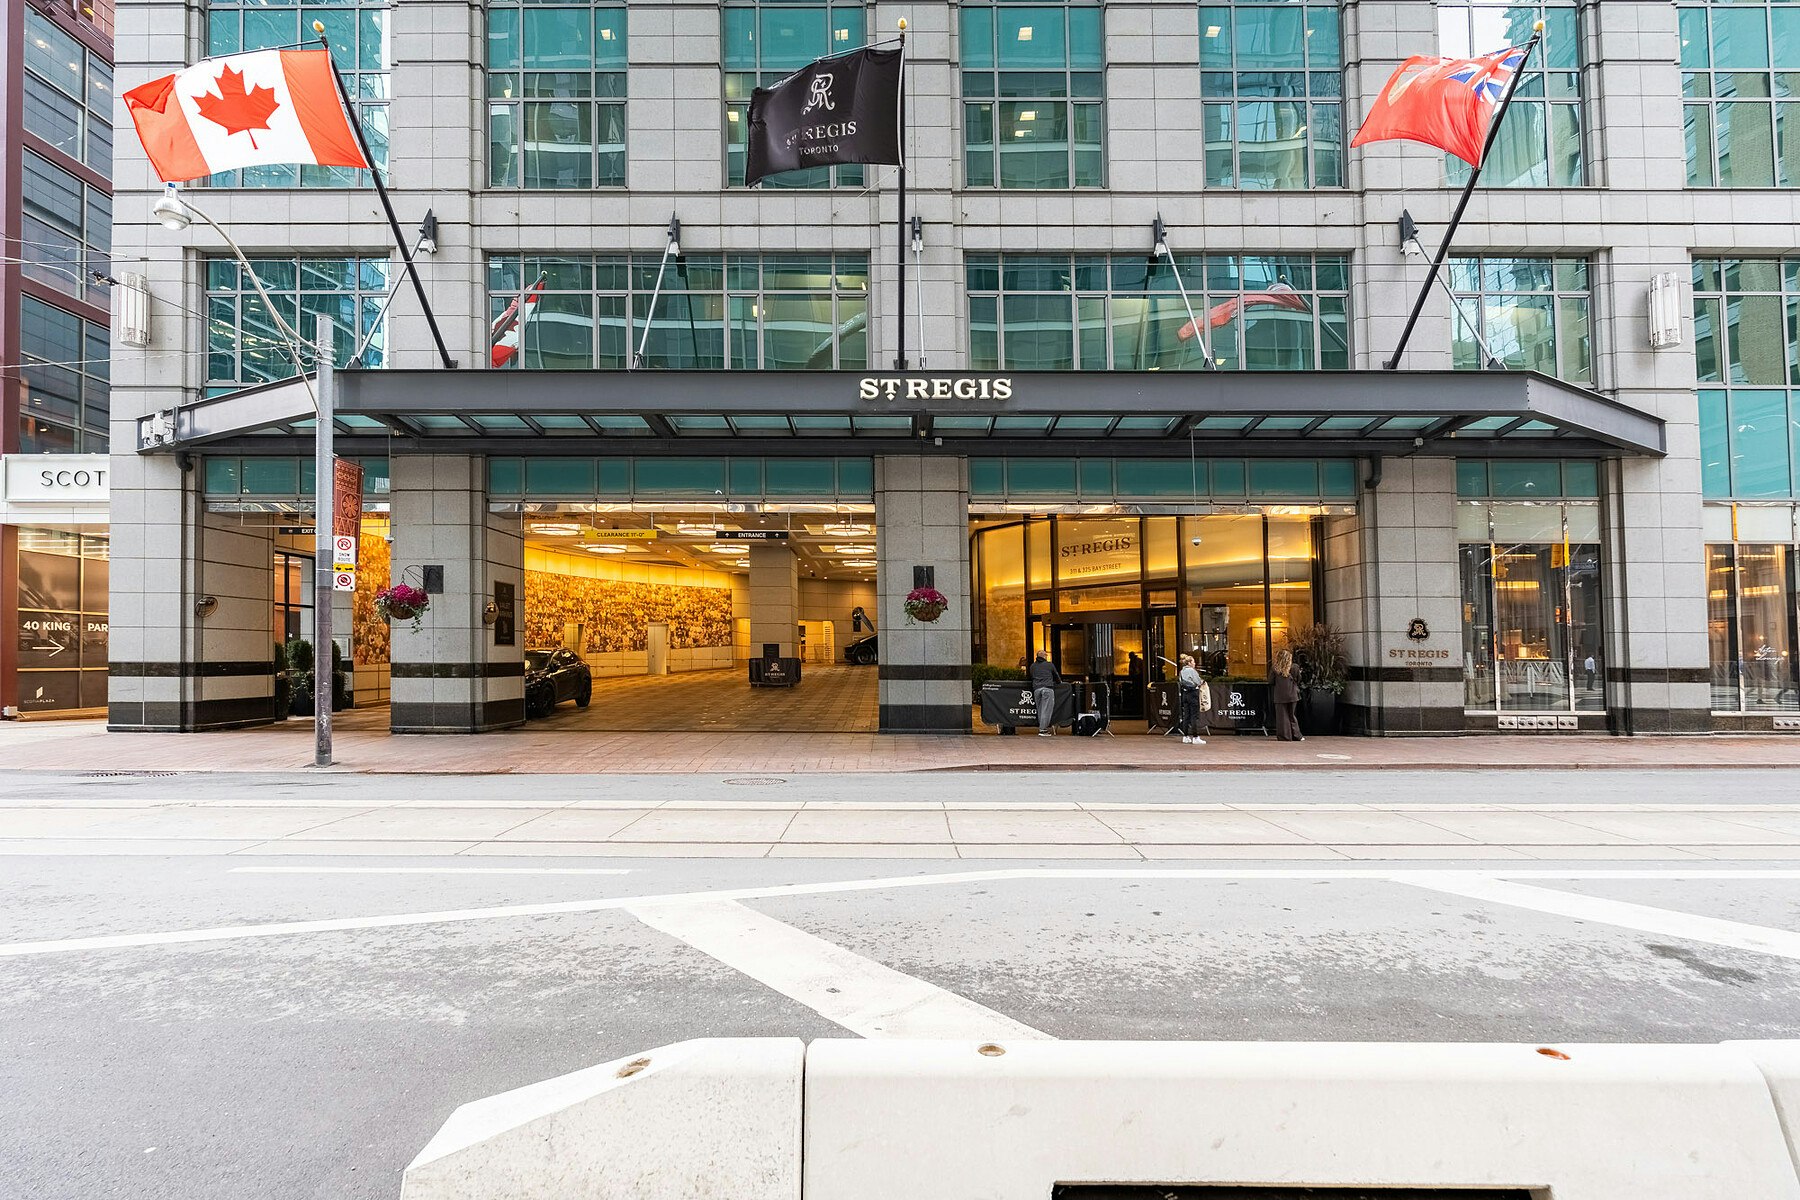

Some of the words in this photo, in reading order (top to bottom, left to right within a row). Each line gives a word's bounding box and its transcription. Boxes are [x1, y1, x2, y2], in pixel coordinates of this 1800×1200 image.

[799, 144, 839, 155] TORONTO
[905, 378, 1013, 400] REGIS
[41, 470, 106, 487] SCOT
[1082, 537, 1131, 554] REGIS
[1102, 563, 1121, 571] STREET
[23, 621, 39, 631] 40
[42, 621, 71, 631] KING
[1389, 649, 1405, 658] ST
[1407, 649, 1449, 659] REGIS
